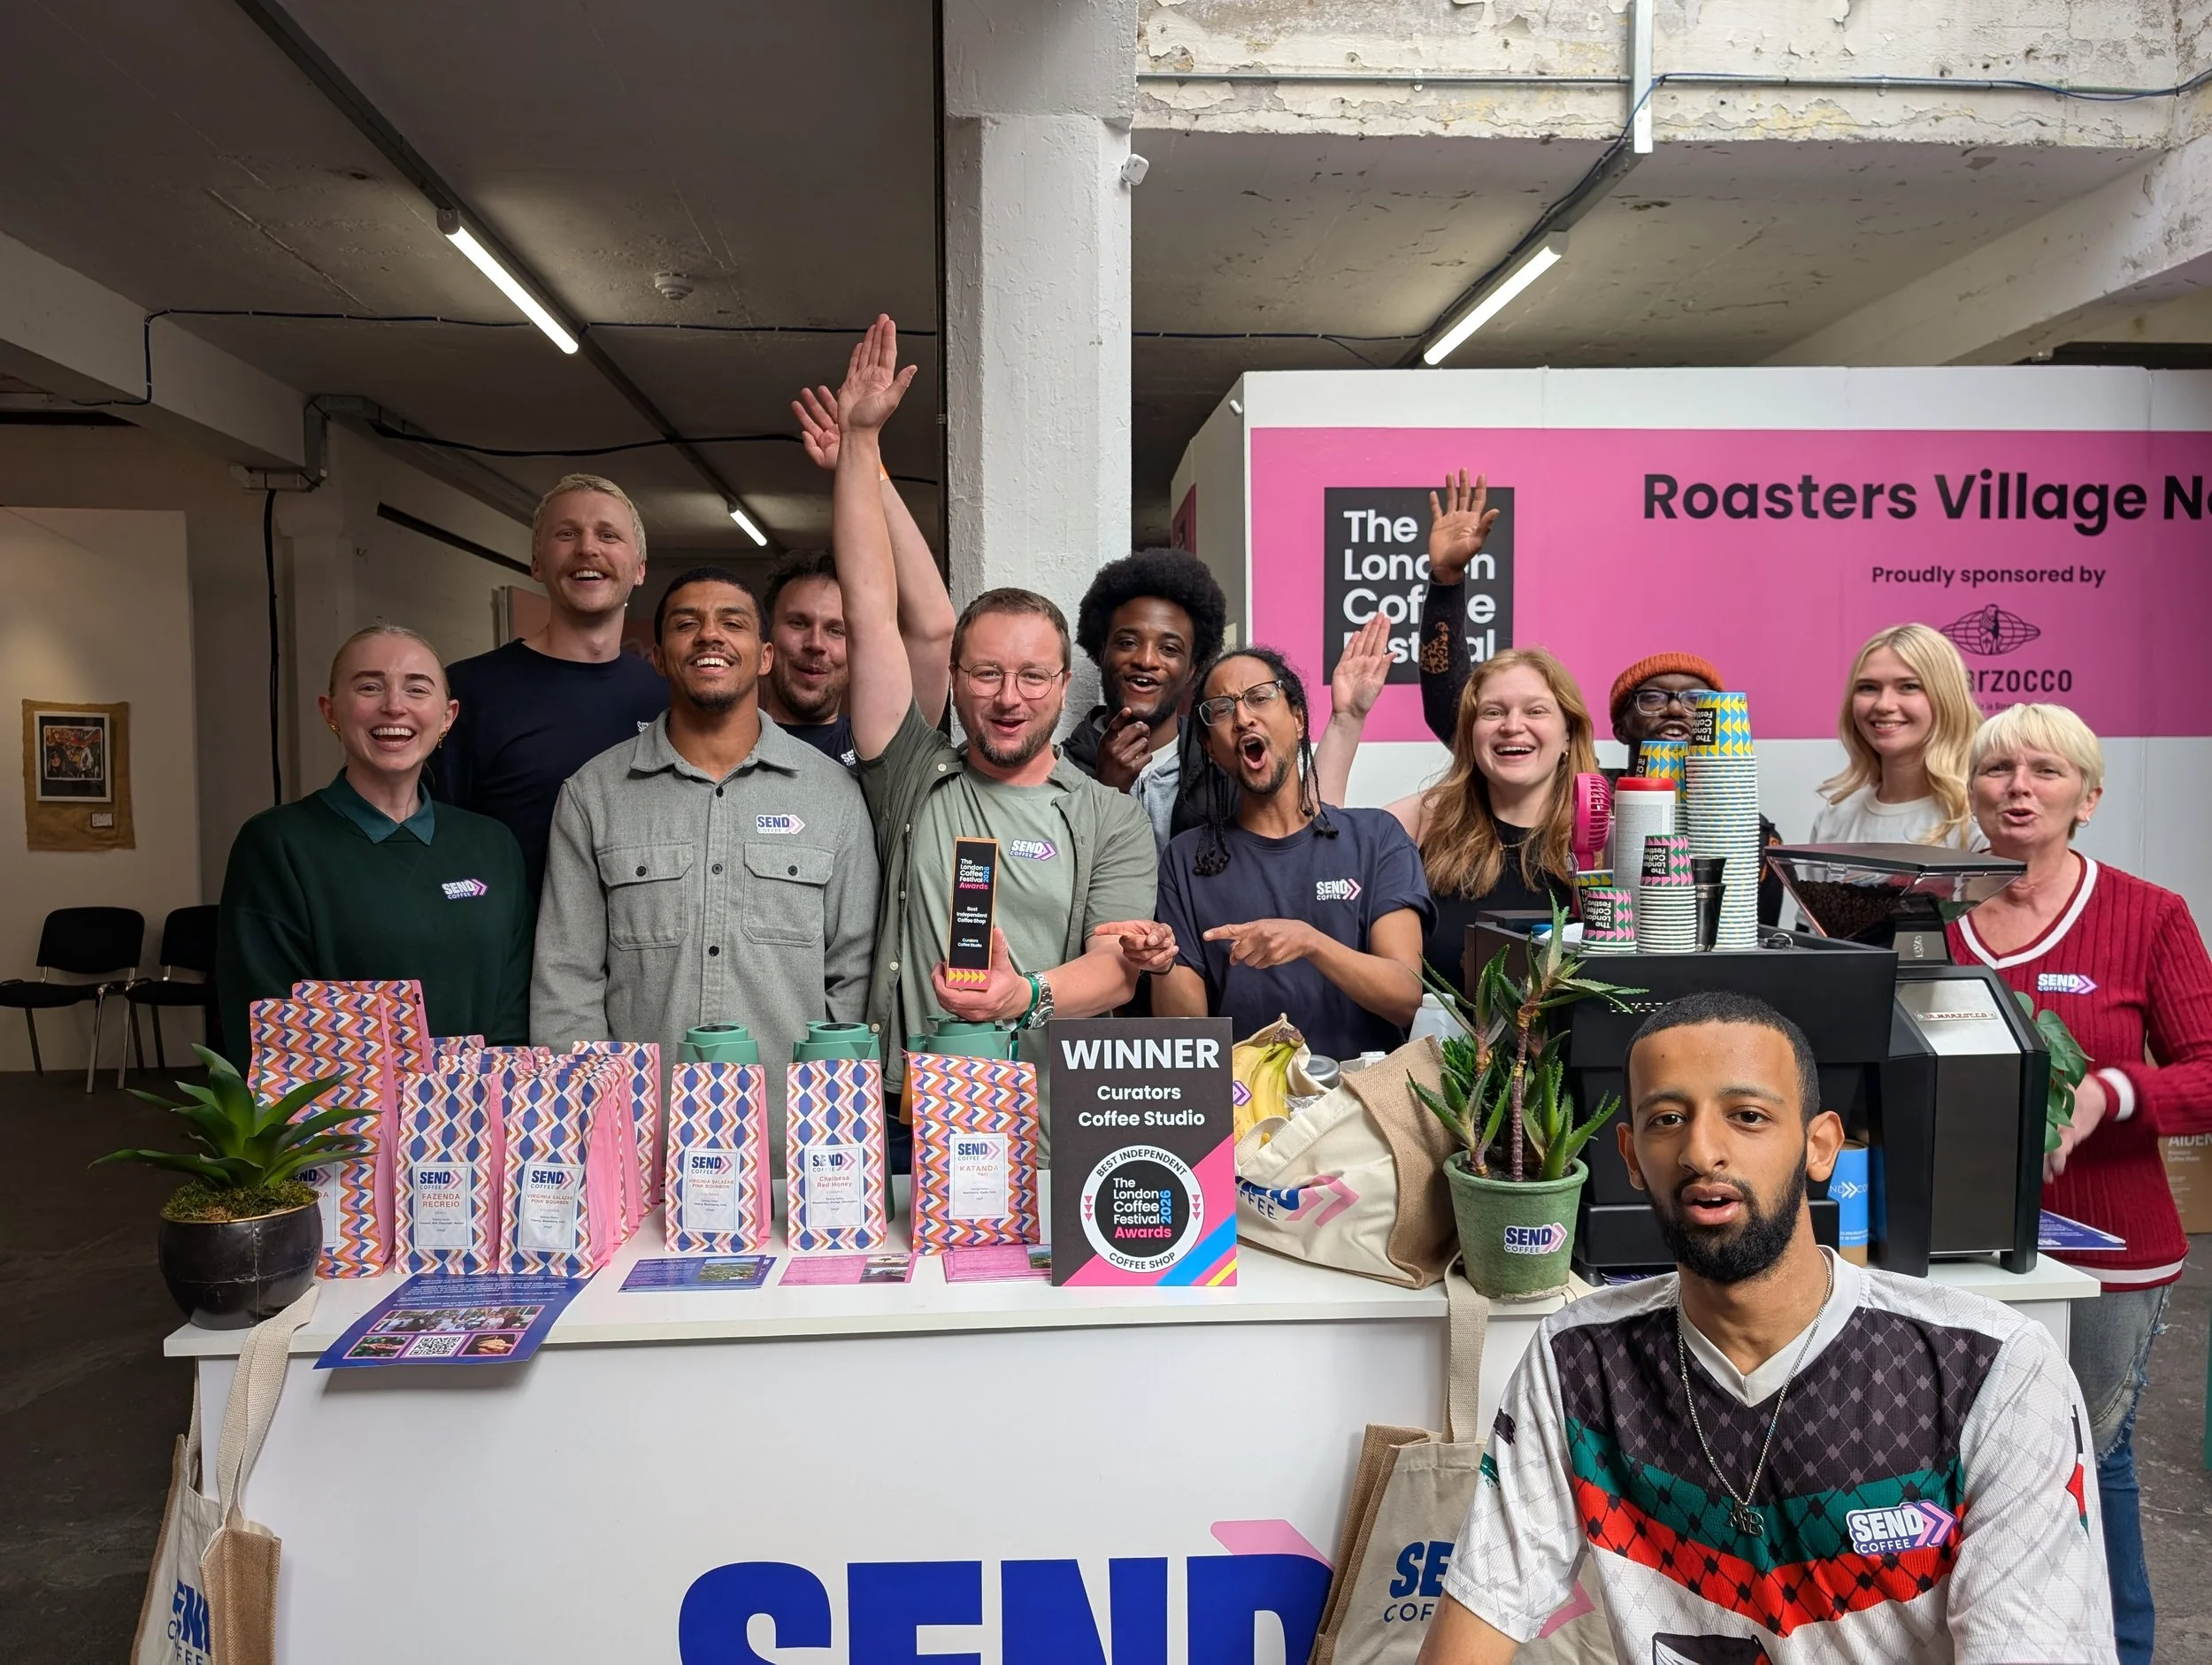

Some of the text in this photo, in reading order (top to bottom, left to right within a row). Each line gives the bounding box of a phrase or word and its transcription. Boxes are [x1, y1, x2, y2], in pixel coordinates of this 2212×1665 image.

[1643, 468, 2212, 536] Roasters Village N
[1343, 510, 1417, 542] The
[1344, 549, 1495, 580] Lonn
[1871, 564, 2106, 588] Proudly sponsored by
[1343, 585, 1496, 625] Cofe
[841, 749, 856, 763] SE
[757, 817, 790, 828] SEND
[1011, 840, 1045, 855] SEND
[442, 879, 476, 894] SEND
[1316, 879, 1348, 894] SEND
[2038, 973, 2078, 987] SEND
[1061, 1039, 1220, 1070] WINNER
[1097, 1086, 1181, 1101] Curators
[1079, 1109, 1205, 1127] Coffee Studio
[957, 1143, 988, 1155] SEND
[691, 1155, 722, 1169] SEND
[812, 1154, 843, 1167] SEND
[1096, 1148, 1187, 1178] BEST INDEPENDENT
[419, 1171, 451, 1185] SEND
[531, 1170, 565, 1185] SEND
[1113, 1178, 1136, 1188] The
[1113, 1188, 1159, 1200] London
[1113, 1200, 1159, 1213] Coffee
[1160, 1190, 1171, 1224] 2026
[1114, 1213, 1160, 1224] Festival
[1114, 1225, 1172, 1239] Awards
[1505, 1227, 1552, 1246] SEND
[1109, 1252, 1176, 1270] COFFEE SHOP
[1851, 1508, 1924, 1542] SEND
[1859, 1538, 1911, 1554] COFFEE
[1389, 1540, 1455, 1599] SE
[1383, 1602, 1434, 1623] COF
